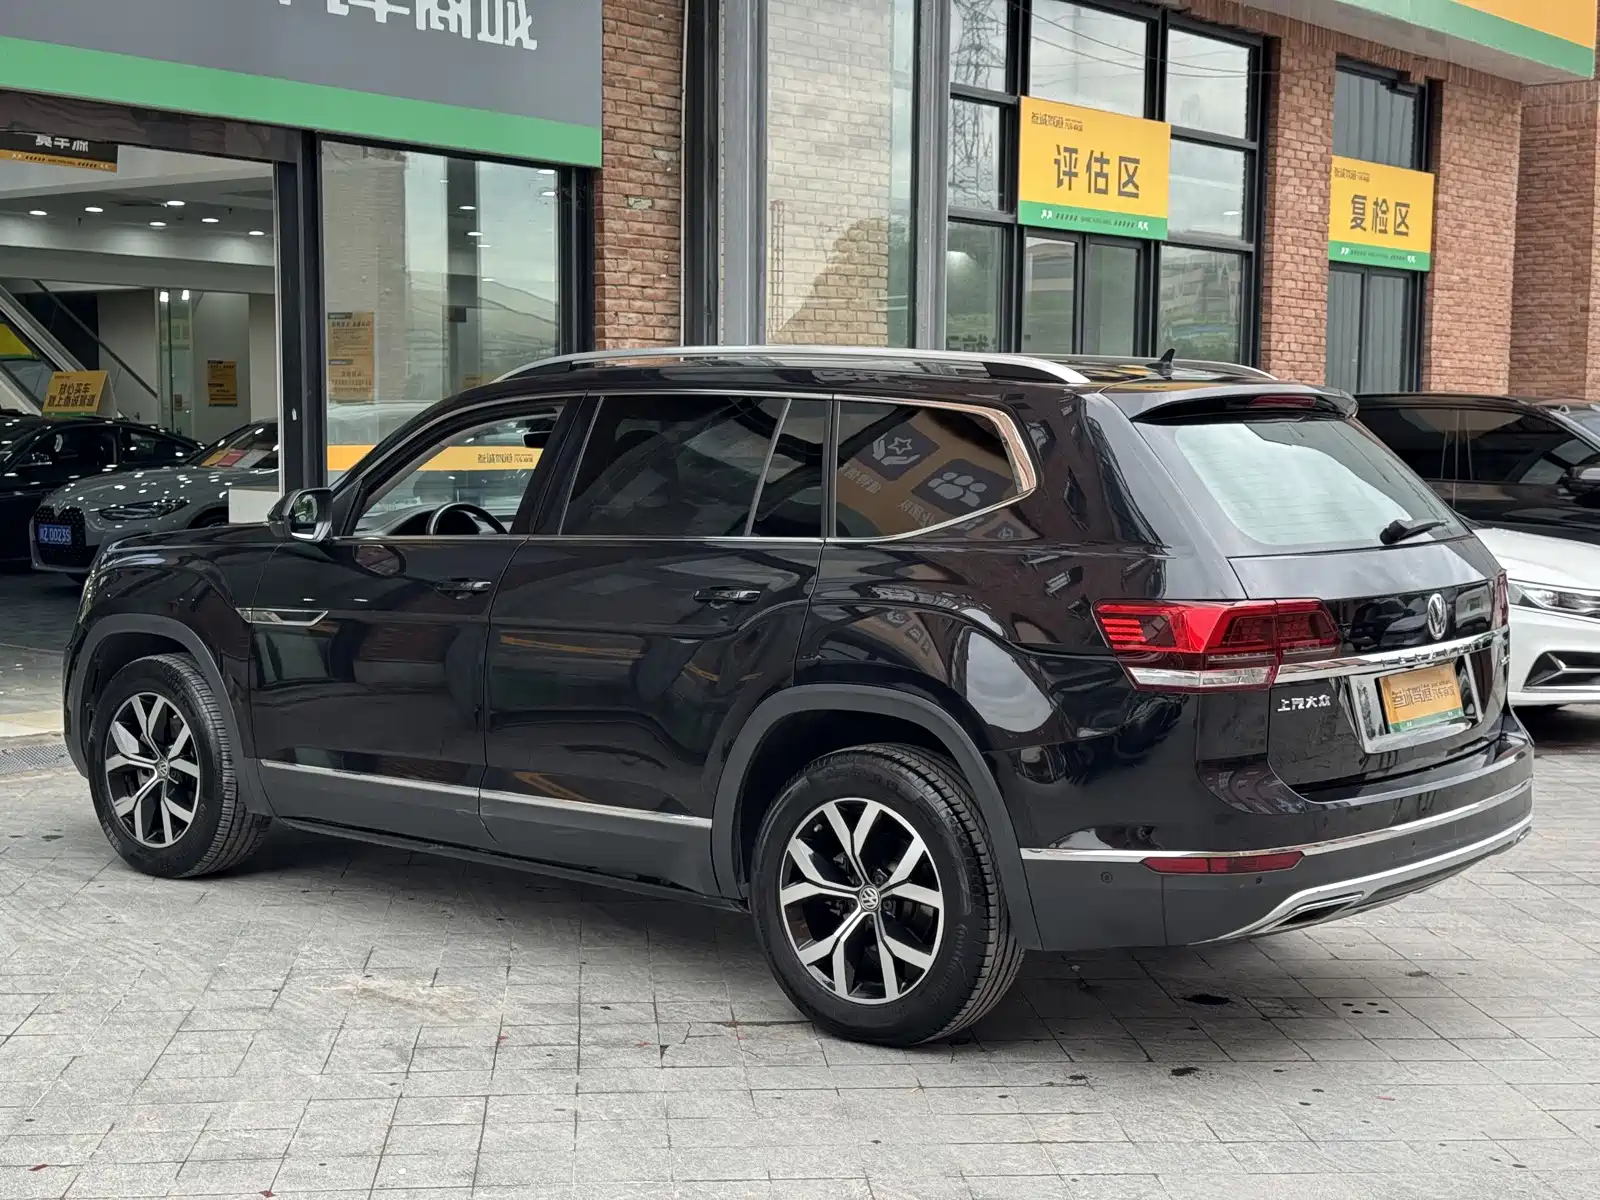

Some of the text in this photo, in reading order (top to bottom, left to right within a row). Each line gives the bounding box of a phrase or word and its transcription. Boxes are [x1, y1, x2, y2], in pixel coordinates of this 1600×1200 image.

[1053, 143, 1141, 199] 评估区
[1350, 194, 1411, 237] 复检区
[1277, 694, 1331, 712] 上汽大众
